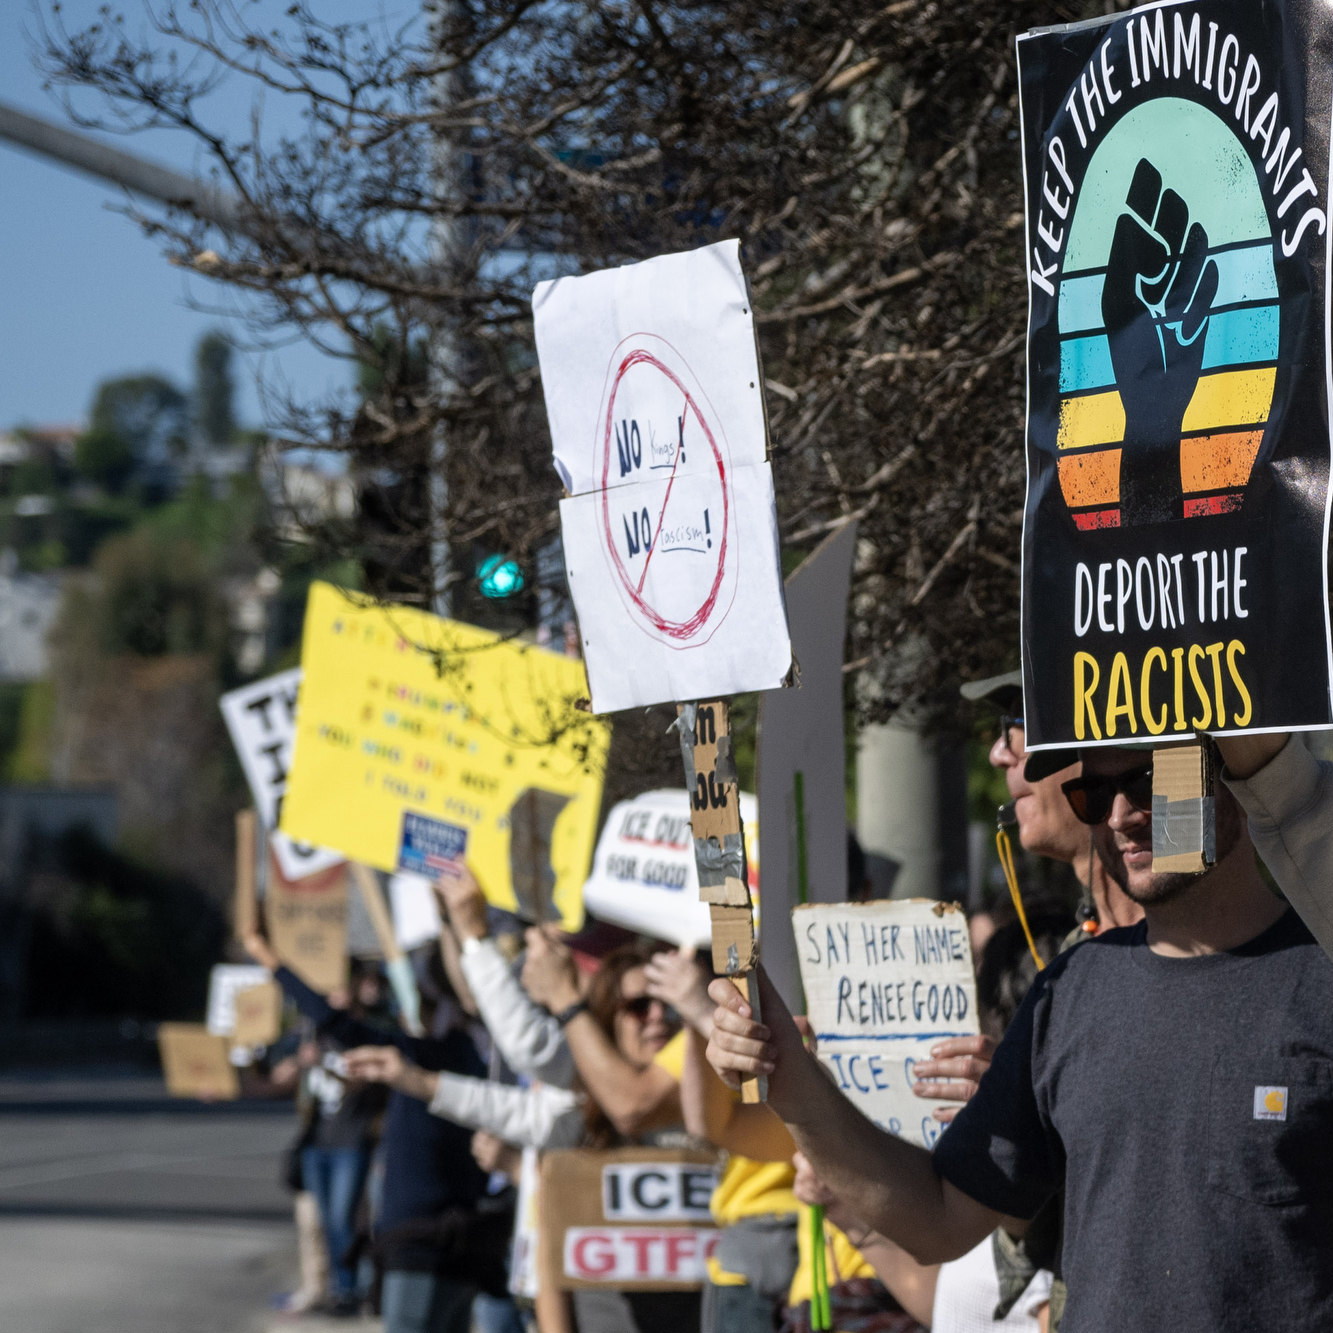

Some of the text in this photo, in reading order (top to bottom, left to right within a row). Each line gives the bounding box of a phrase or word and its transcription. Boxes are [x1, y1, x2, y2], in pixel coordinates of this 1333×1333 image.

[1031, 8, 1327, 297] KEEP THE IMMIGRANTS
[615, 418, 642, 478] NO
[622, 506, 652, 559] NO
[1074, 546, 1249, 637] DEPORT THE
[1073, 638, 1253, 741] RACISTS
[806, 921, 851, 969] SAY
[861, 921, 905, 967] HER
[837, 975, 969, 1026] RENEE GOOD
[829, 1053, 890, 1094] ICE
[607, 1171, 713, 1211] ICE
